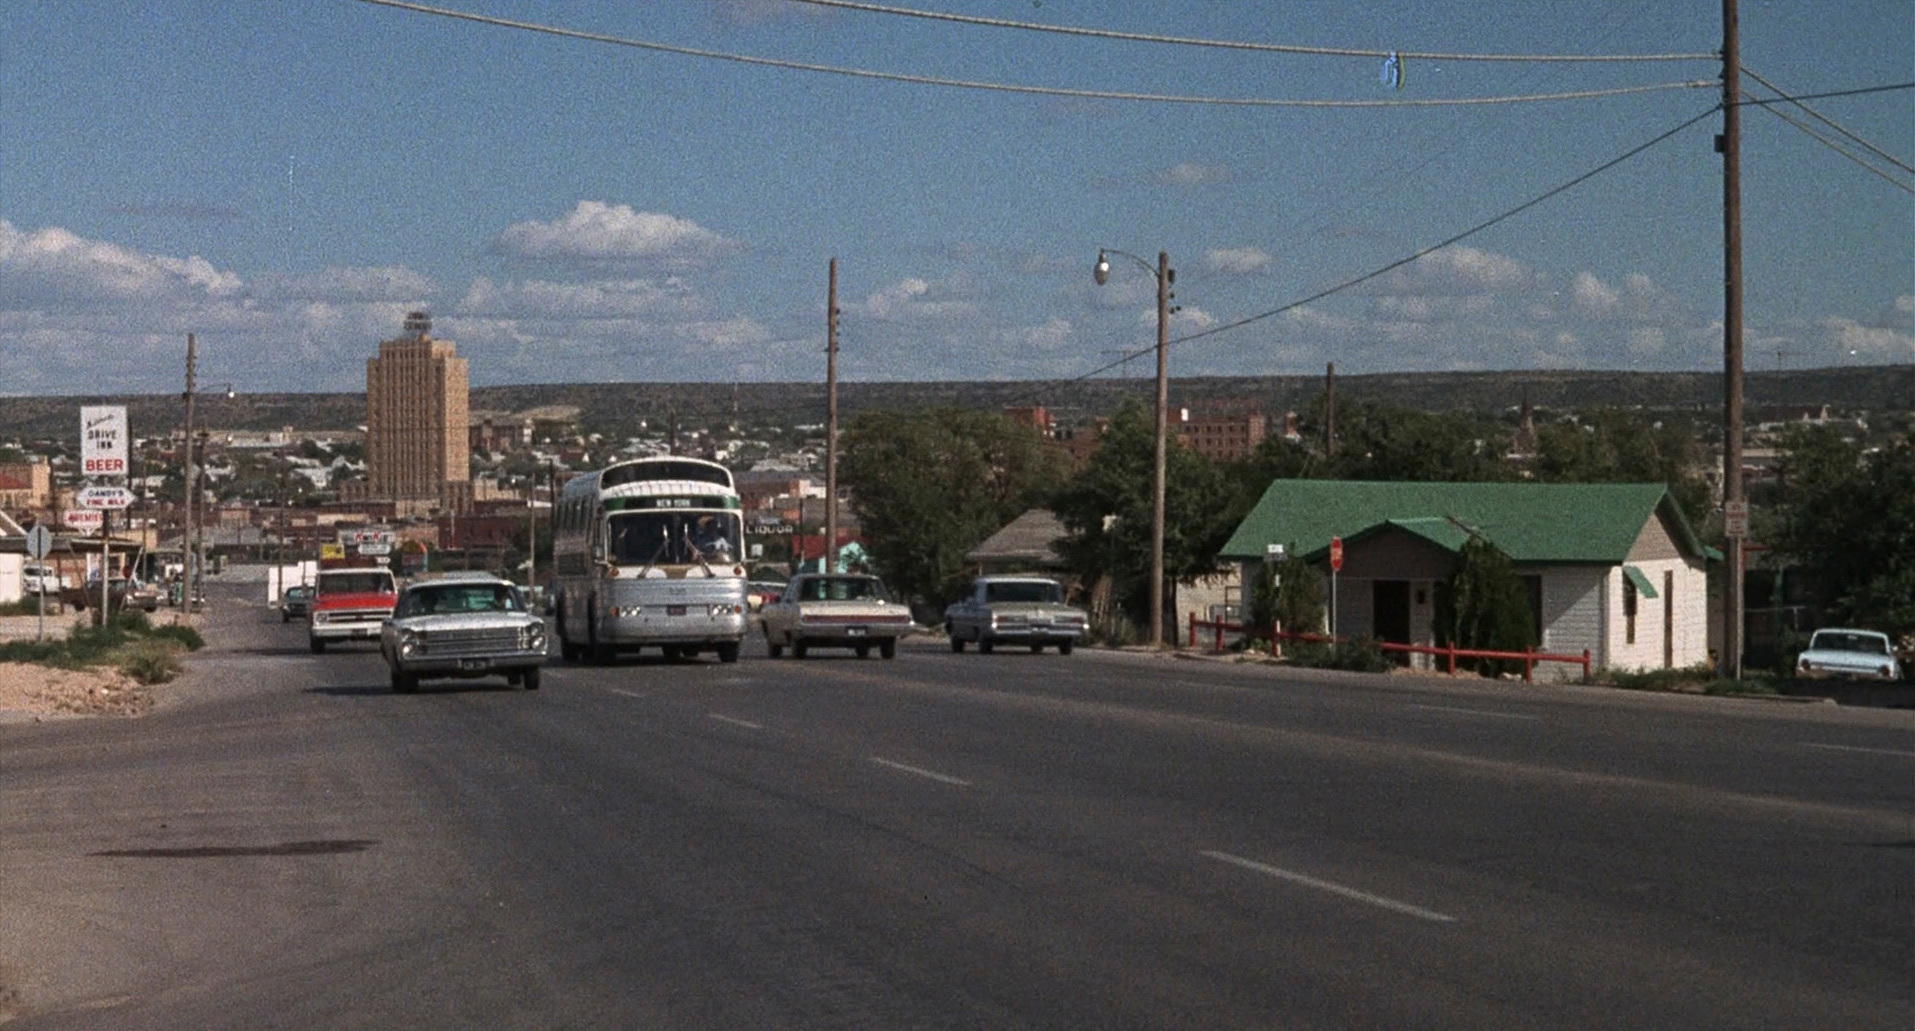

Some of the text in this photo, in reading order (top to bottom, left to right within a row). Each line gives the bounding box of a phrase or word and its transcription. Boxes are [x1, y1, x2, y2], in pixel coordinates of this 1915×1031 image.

[88, 430, 116, 440] DRIVE
[86, 459, 123, 471] BEER
[656, 499, 690, 507] NEW YORK
[746, 525, 793, 534] LIQUOR
